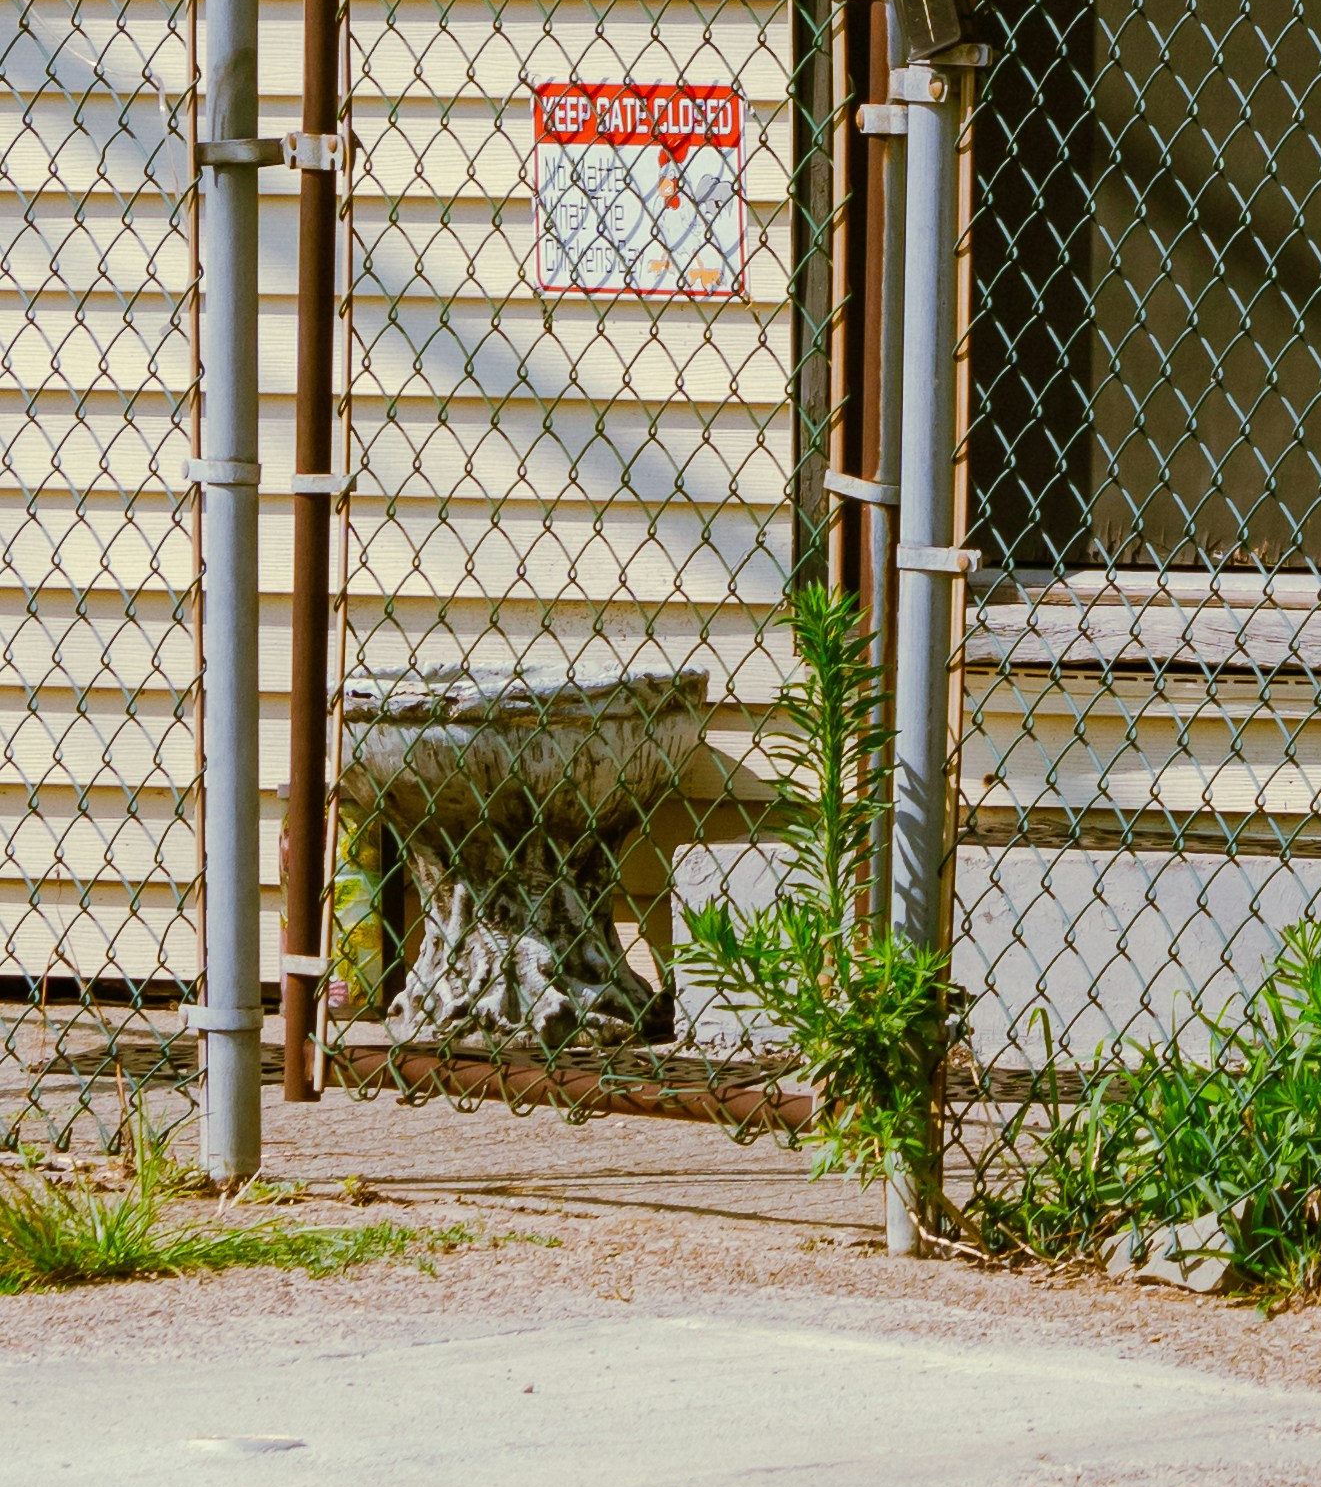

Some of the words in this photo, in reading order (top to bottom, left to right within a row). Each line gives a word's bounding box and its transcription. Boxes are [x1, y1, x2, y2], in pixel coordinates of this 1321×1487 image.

[542, 96, 591, 132] KEEP
[596, 96, 649, 134] GATE
[653, 96, 733, 135] CLOSED
[544, 156, 566, 191] No
[571, 156, 630, 193] Matte
